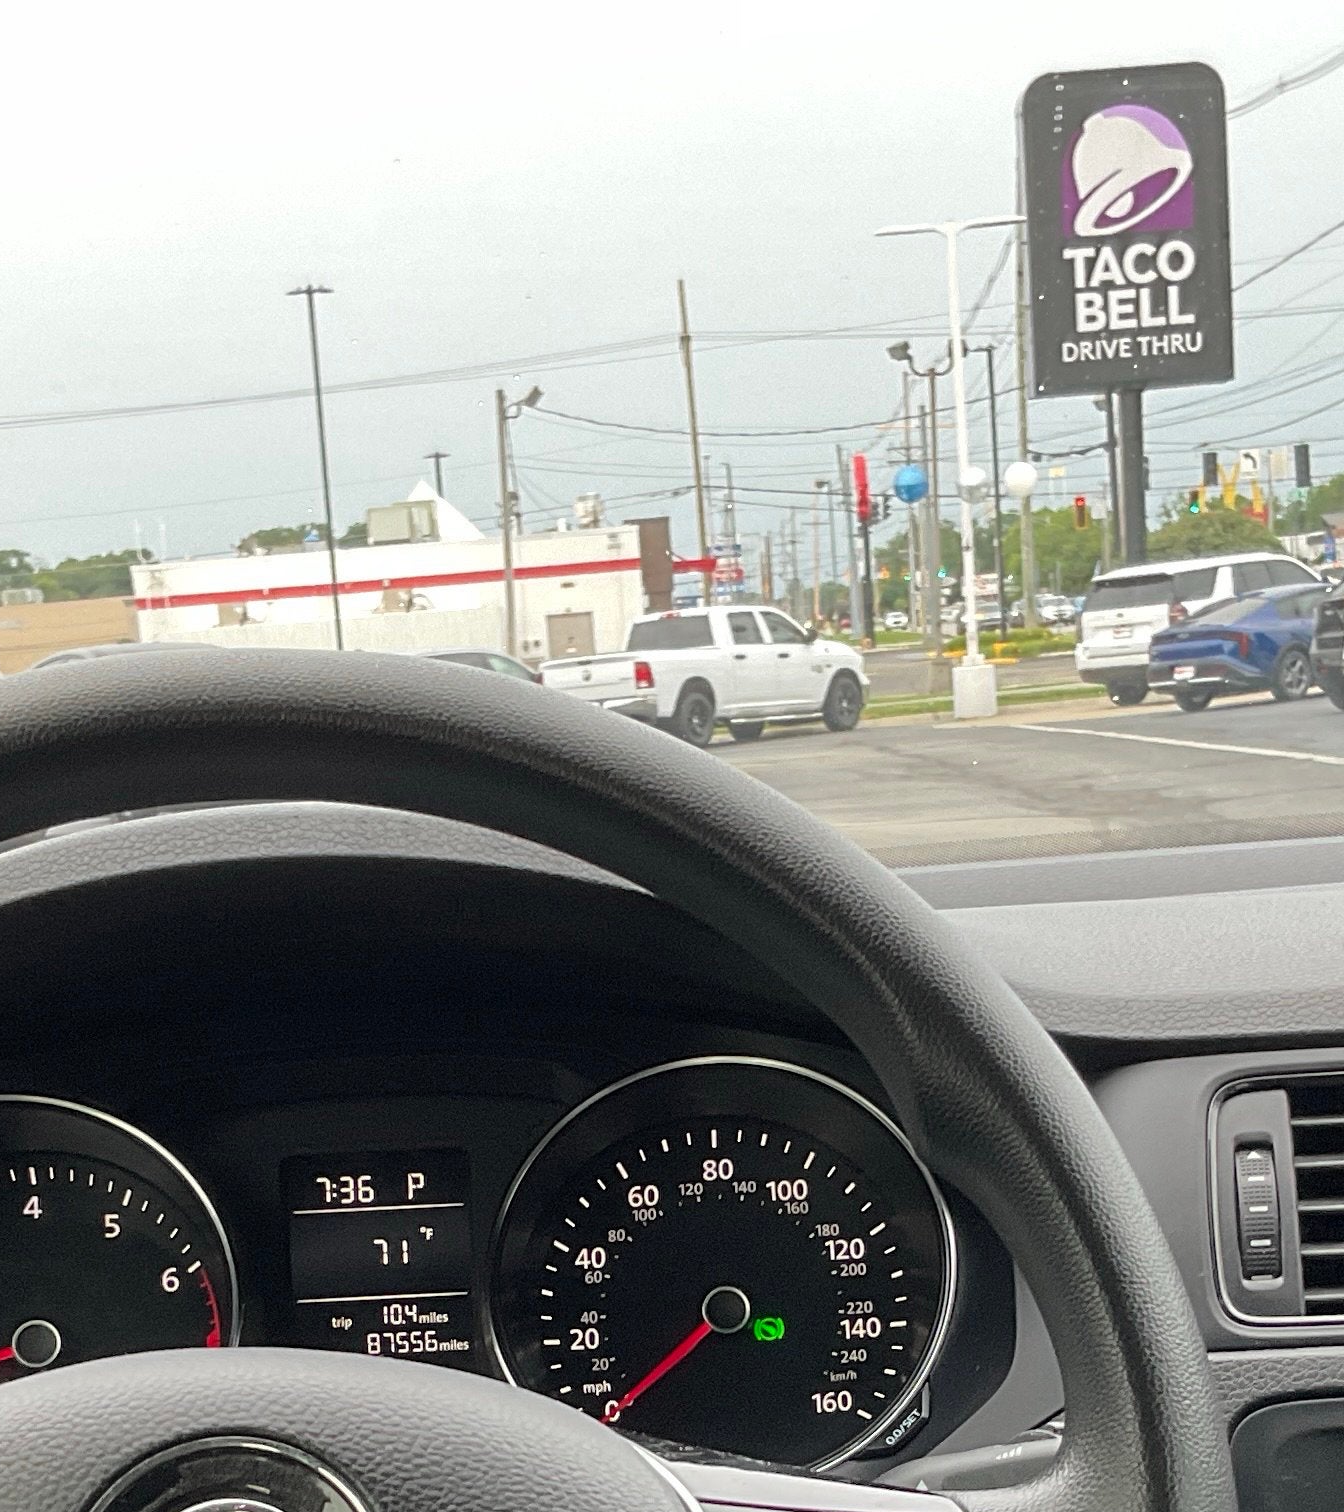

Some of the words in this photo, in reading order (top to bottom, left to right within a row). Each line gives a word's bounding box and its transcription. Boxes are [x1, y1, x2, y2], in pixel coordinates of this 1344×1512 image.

[1062, 240, 1196, 289] TACO
[1074, 285, 1196, 333] BELL
[1061, 338, 1132, 363] DRIVE
[1137, 332, 1204, 357] THRU
[702, 1158, 734, 1182] 80
[316, 1174, 375, 1204] 7:36
[407, 1172, 425, 1200] P
[627, 1184, 659, 1208] 60
[678, 1182, 704, 1197] 120
[731, 1180, 757, 1195] 140
[765, 1179, 809, 1202] 100
[23, 1195, 42, 1219] 4
[632, 1208, 657, 1222] 100
[784, 1202, 809, 1215] 160
[104, 1213, 120, 1239] 5
[607, 1229, 626, 1243] 80
[815, 1223, 840, 1237] 180
[373, 1238, 409, 1266] 71
[574, 1247, 606, 1271] 40
[824, 1237, 865, 1261] 120
[161, 1267, 180, 1292] 6
[584, 1271, 604, 1284] 60
[840, 1262, 867, 1276] 200
[331, 1316, 353, 1330] trip
[382, 1303, 418, 1326] 10.4
[418, 1311, 449, 1324] miles
[580, 1311, 598, 1324] 40
[846, 1301, 874, 1315] 220
[569, 1327, 600, 1352] 20
[840, 1317, 882, 1341] 140
[367, 1330, 438, 1354] 87556
[439, 1339, 470, 1352] miles
[591, 1358, 609, 1372] 20
[840, 1348, 867, 1364] 240
[829, 1369, 858, 1382] km/h
[582, 1380, 611, 1396] mph
[811, 1390, 853, 1413] 160
